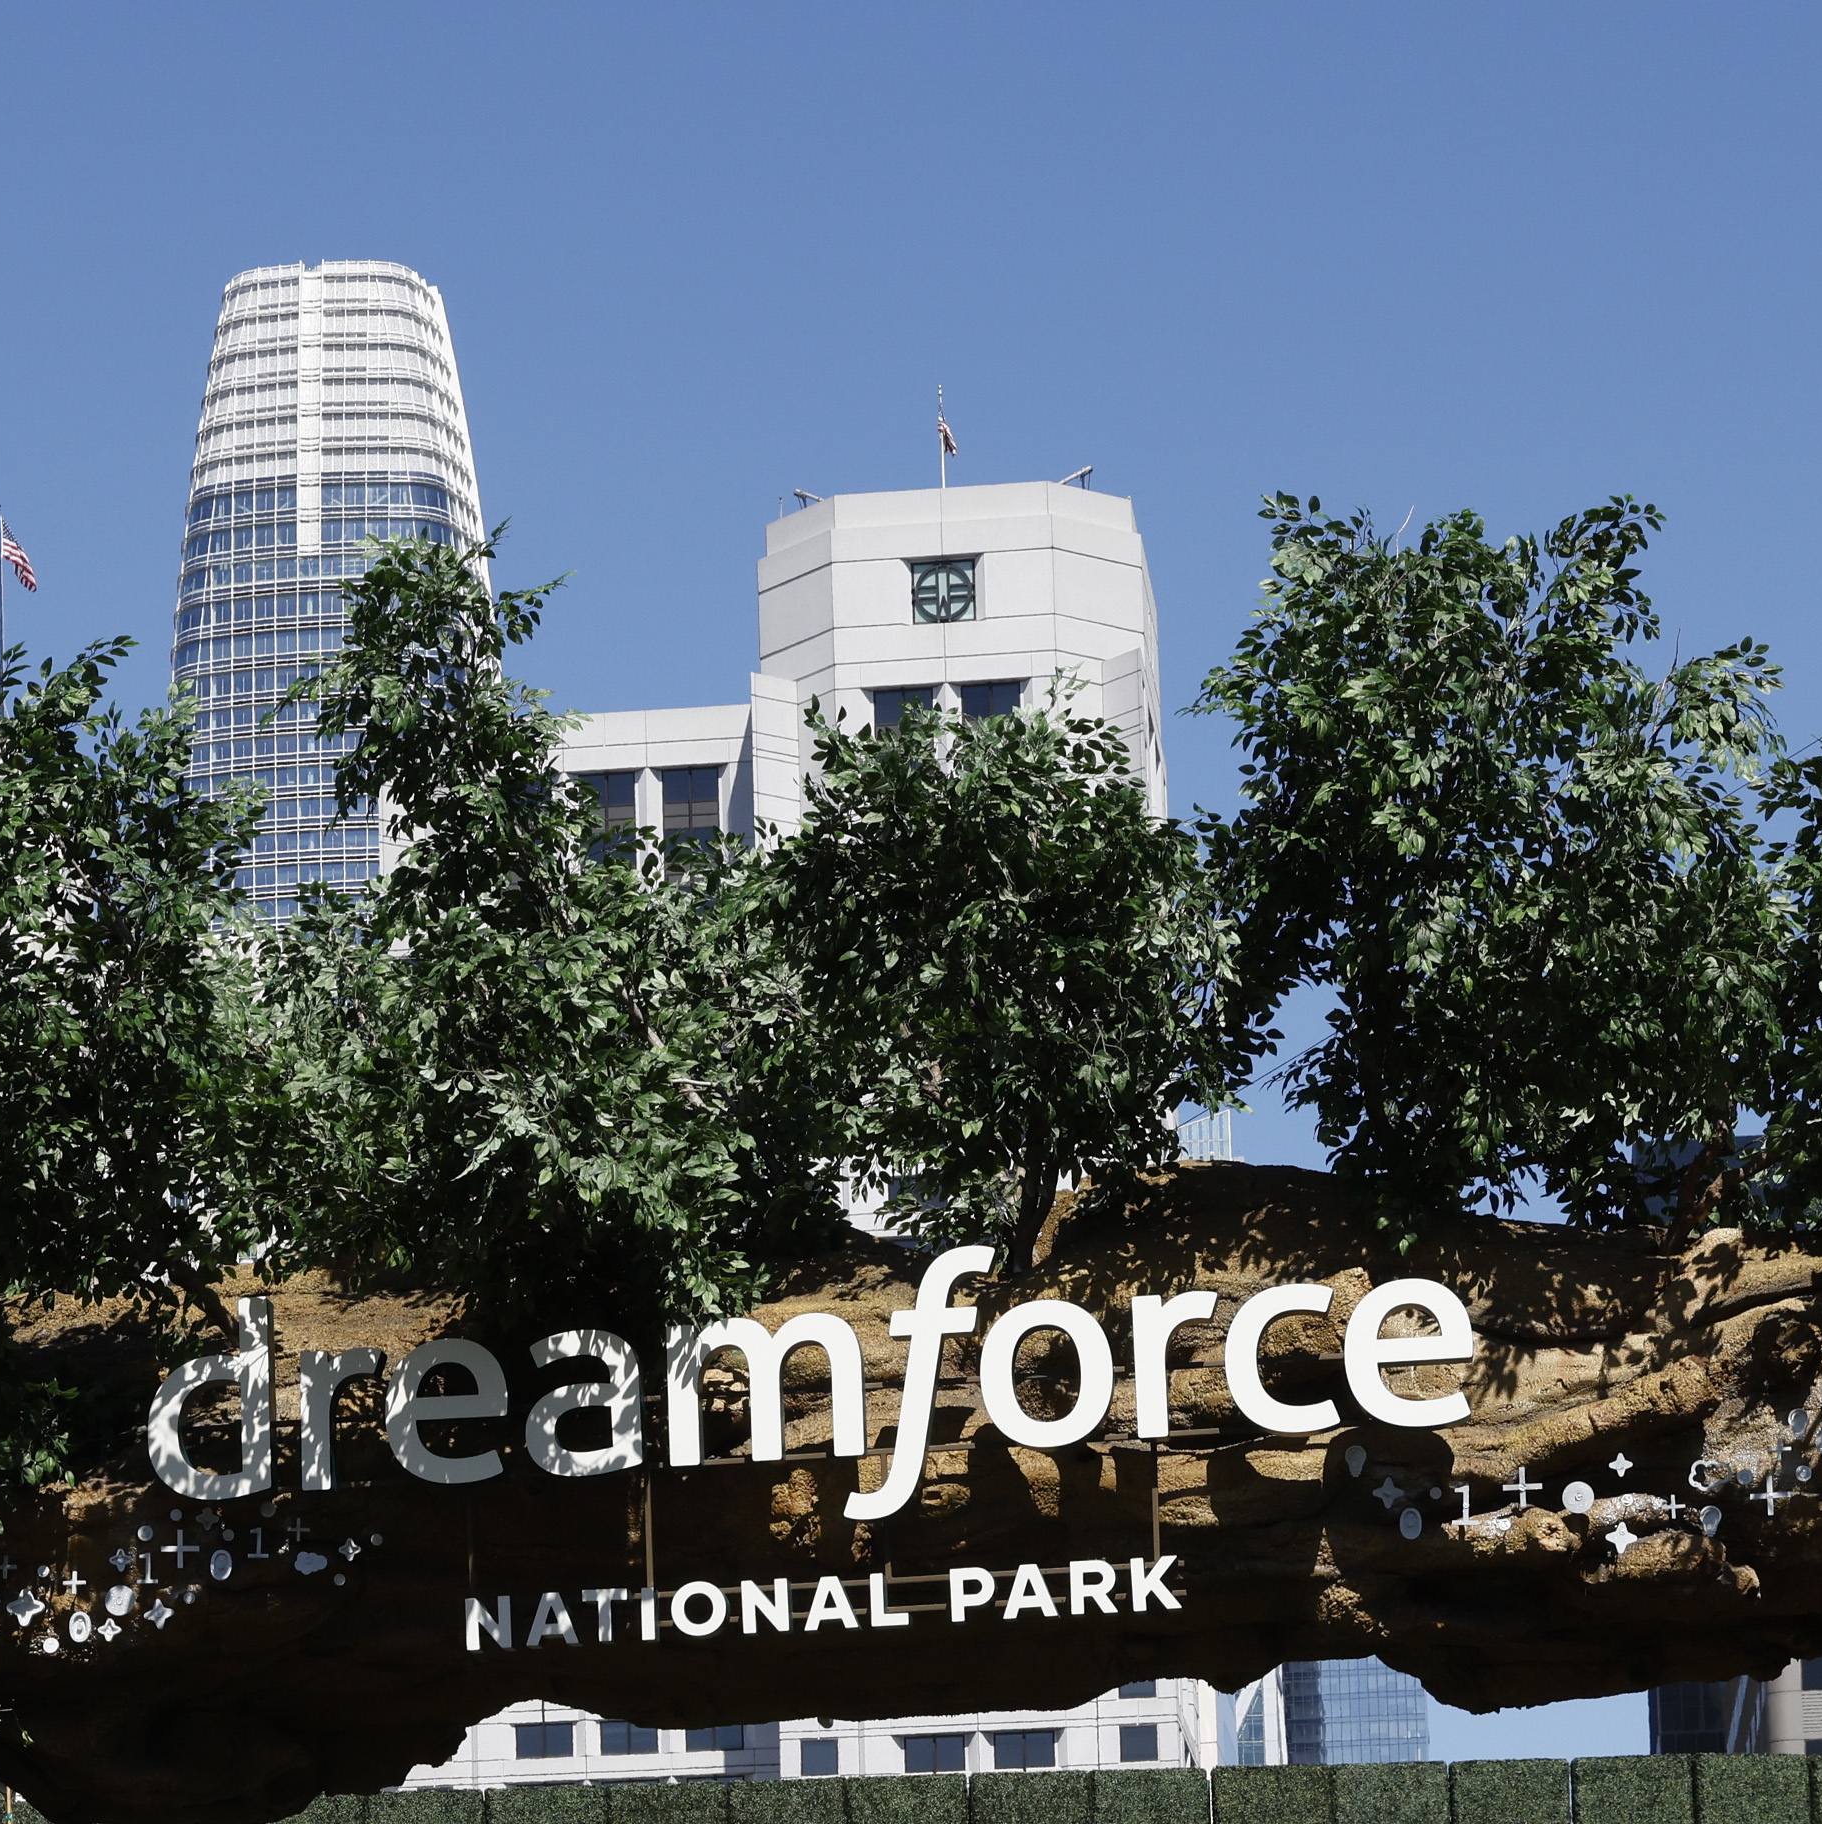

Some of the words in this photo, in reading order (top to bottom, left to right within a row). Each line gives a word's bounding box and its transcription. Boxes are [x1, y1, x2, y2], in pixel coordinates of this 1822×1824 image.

[147, 1245, 1474, 1521] dreamforce
[465, 1572, 910, 1652] NATIONAL
[948, 1554, 1183, 1623] PARK
